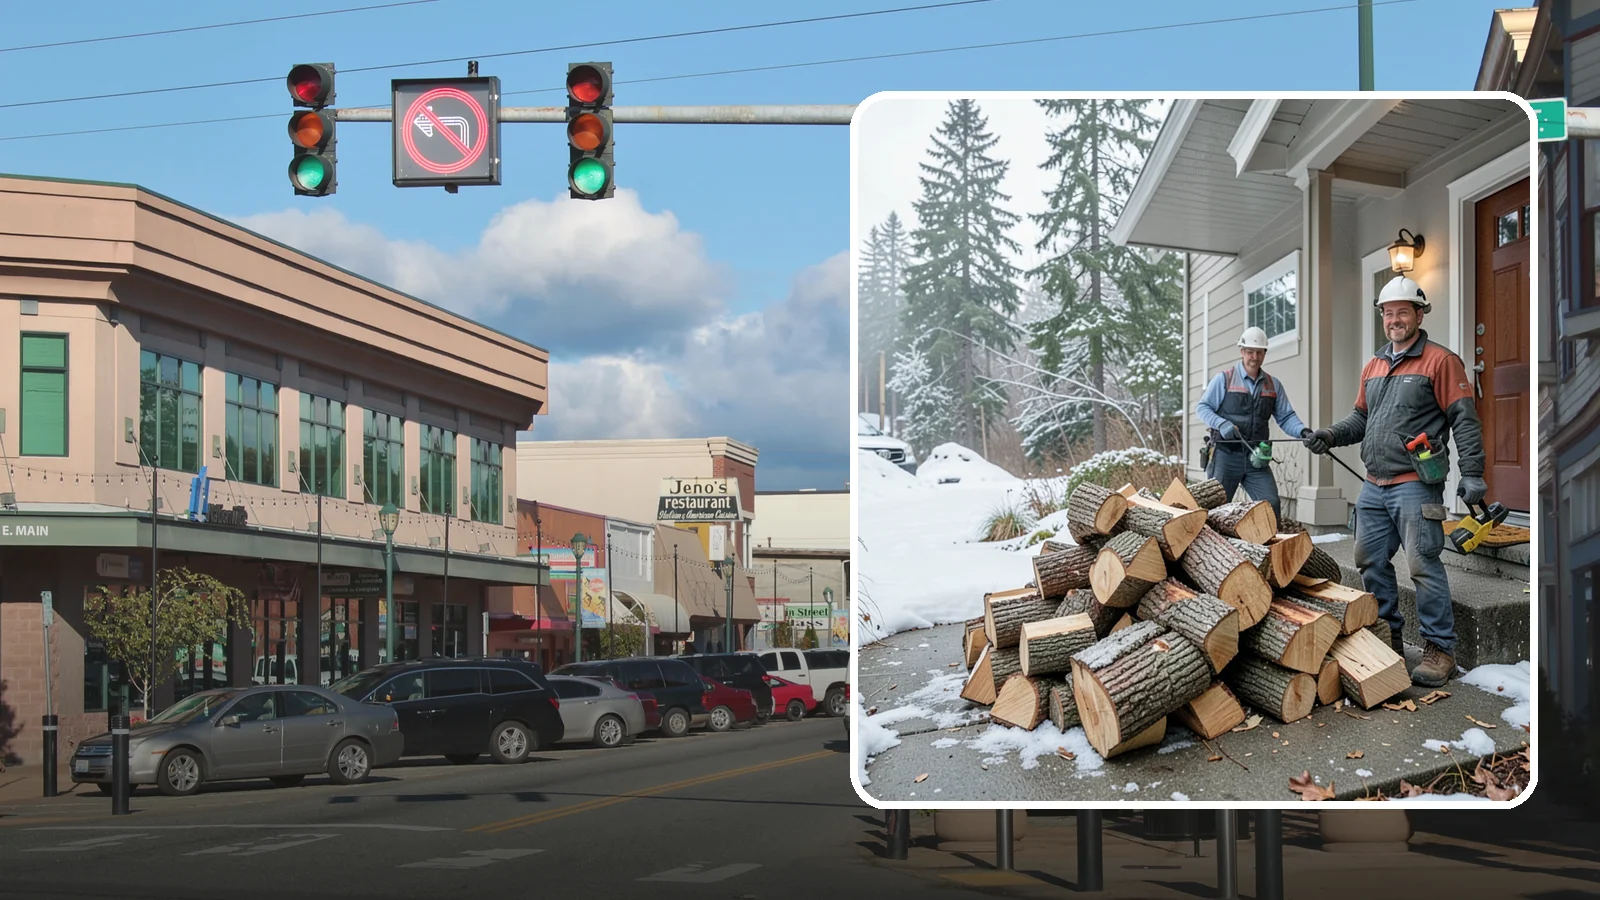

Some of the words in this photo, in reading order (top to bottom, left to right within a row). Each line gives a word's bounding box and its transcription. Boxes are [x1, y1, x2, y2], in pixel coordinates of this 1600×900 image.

[669, 480, 728, 495] Jeno's
[665, 496, 731, 509] restaurant
[658, 509, 681, 520] Italian
[686, 509, 714, 519] American
[715, 509, 737, 519] Cuisine
[2, 525, 13, 536] E.
[15, 525, 49, 536] MAIN
[797, 607, 828, 616] Street
